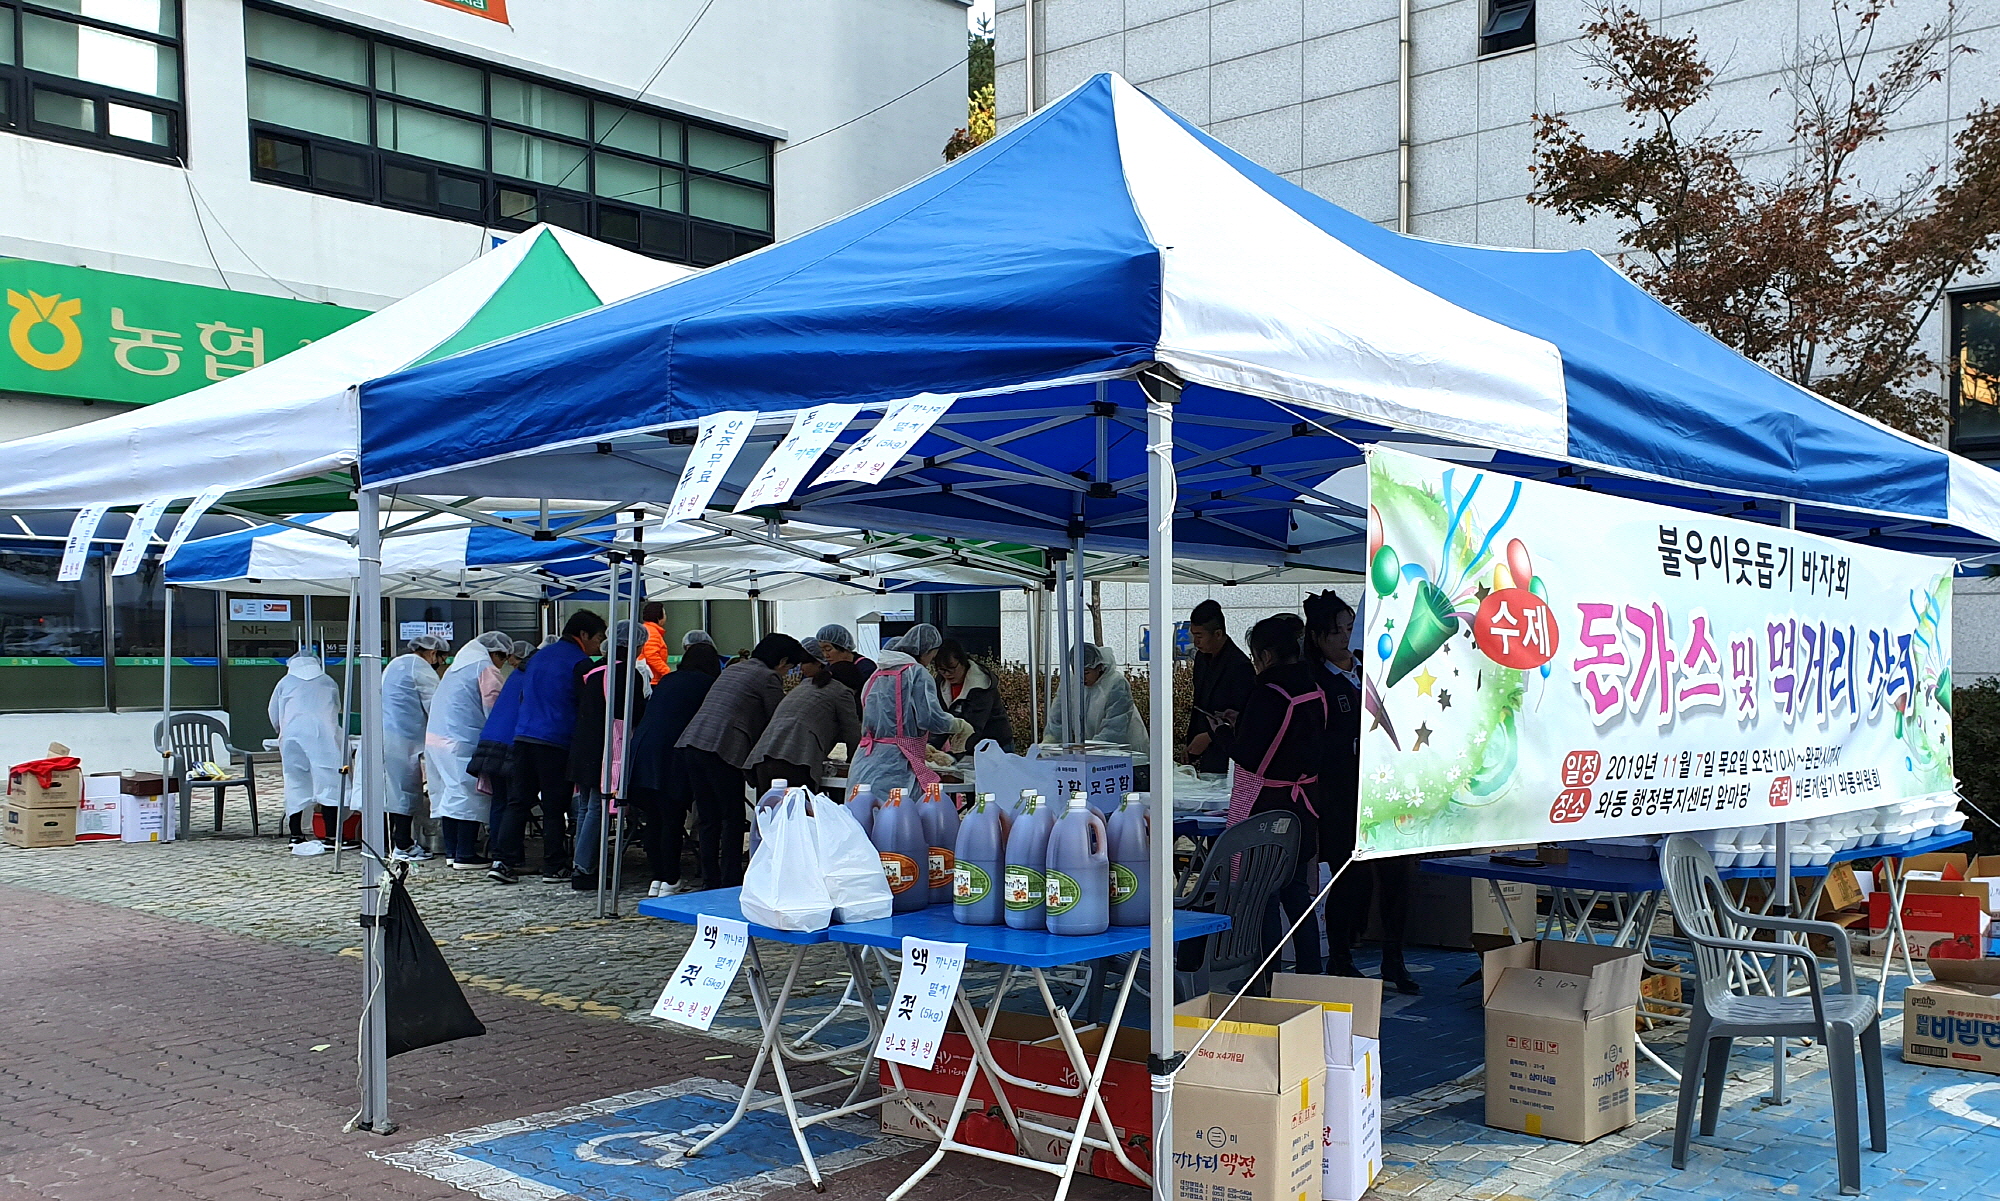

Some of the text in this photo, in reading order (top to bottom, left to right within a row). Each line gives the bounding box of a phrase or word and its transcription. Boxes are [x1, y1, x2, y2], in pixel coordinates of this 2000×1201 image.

[109, 307, 265, 381] 농협
[1658, 525, 1850, 600] 불우이웃돕기 바자회
[242, 625, 267, 635] NH
[326, 643, 337, 651] 365
[1490, 601, 1551, 657] 수제
[1574, 602, 1721, 715] 돈가스
[1731, 637, 1755, 712] 및
[1767, 618, 1857, 716] 먹거리
[1565, 754, 1599, 786] 일정
[1605, 752, 1658, 780] 2019년
[1663, 751, 1692, 778] 11월
[1696, 751, 1715, 777] 7일
[1718, 749, 1749, 777] 목요일
[1091, 774, 1130, 796] 모금함
[1770, 768, 1882, 806] 주최 바르게살기 와동위원회
[1552, 782, 1751, 822] 장소 와동 행정복지센터 앞마당
[724, 933, 746, 948] 까나리
[715, 956, 737, 972] 멸치
[935, 956, 961, 972] 까나리
[703, 976, 726, 990] (5kg)
[928, 982, 951, 999] 멸치
[920, 1006, 944, 1023] (5kg)
[1198, 1048, 1245, 1063] 5kg x4개입
[1172, 1151, 1218, 1173] 까나리
